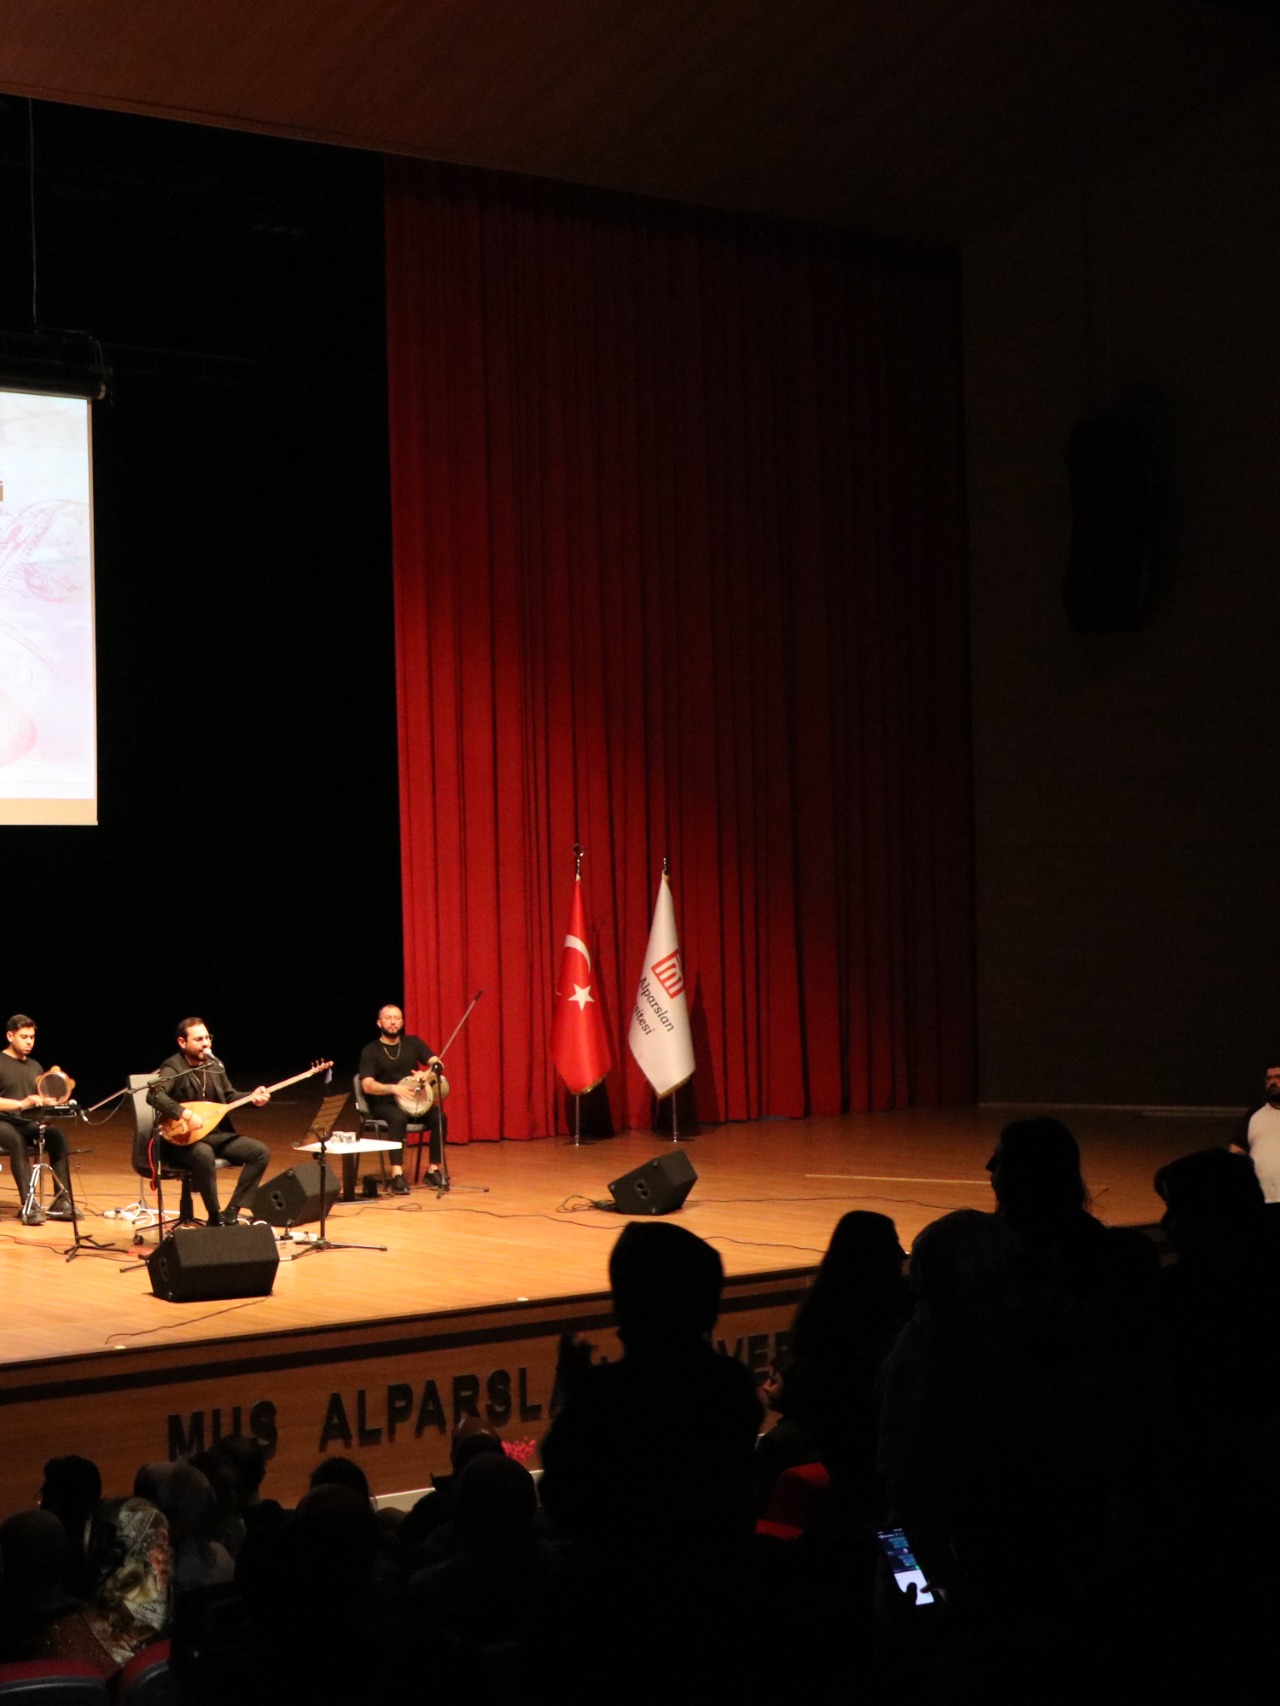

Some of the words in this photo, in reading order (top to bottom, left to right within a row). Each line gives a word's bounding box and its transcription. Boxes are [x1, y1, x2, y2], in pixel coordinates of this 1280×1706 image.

[634, 1004, 655, 1035] sitesi
[640, 976, 674, 1032] Alparslan
[319, 1366, 567, 1453] ALPARSL
